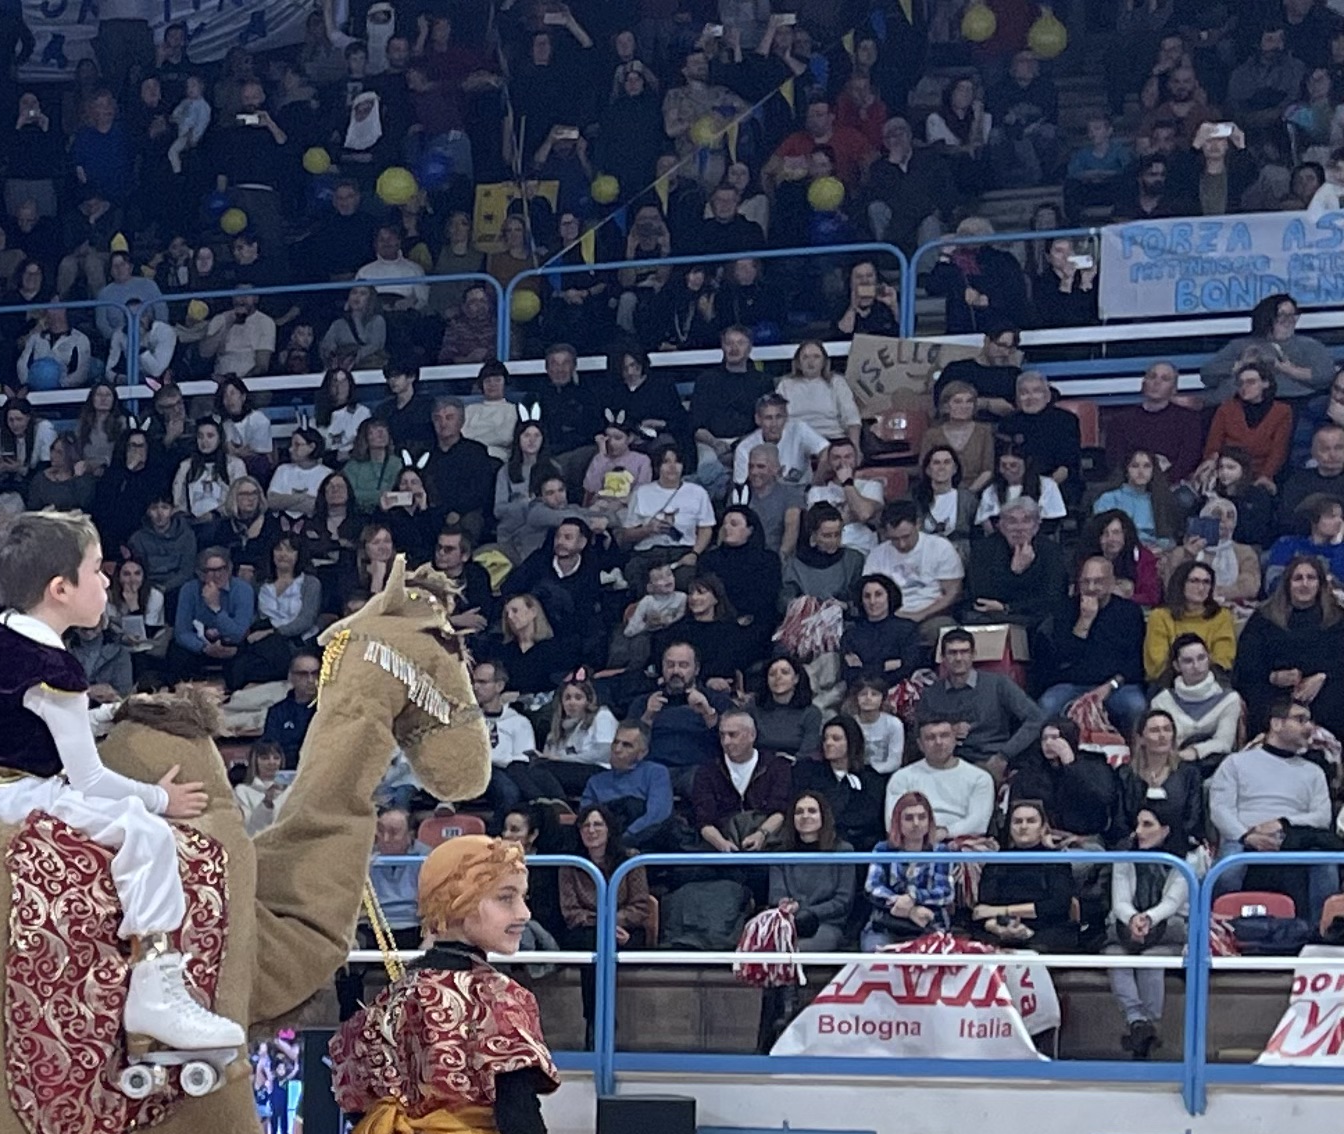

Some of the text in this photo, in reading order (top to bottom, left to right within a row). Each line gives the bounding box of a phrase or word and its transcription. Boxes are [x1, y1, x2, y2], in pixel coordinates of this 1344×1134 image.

[1120, 221, 1252, 259] FORZA
[818, 1015, 1012, 1041] Bologna Italia
